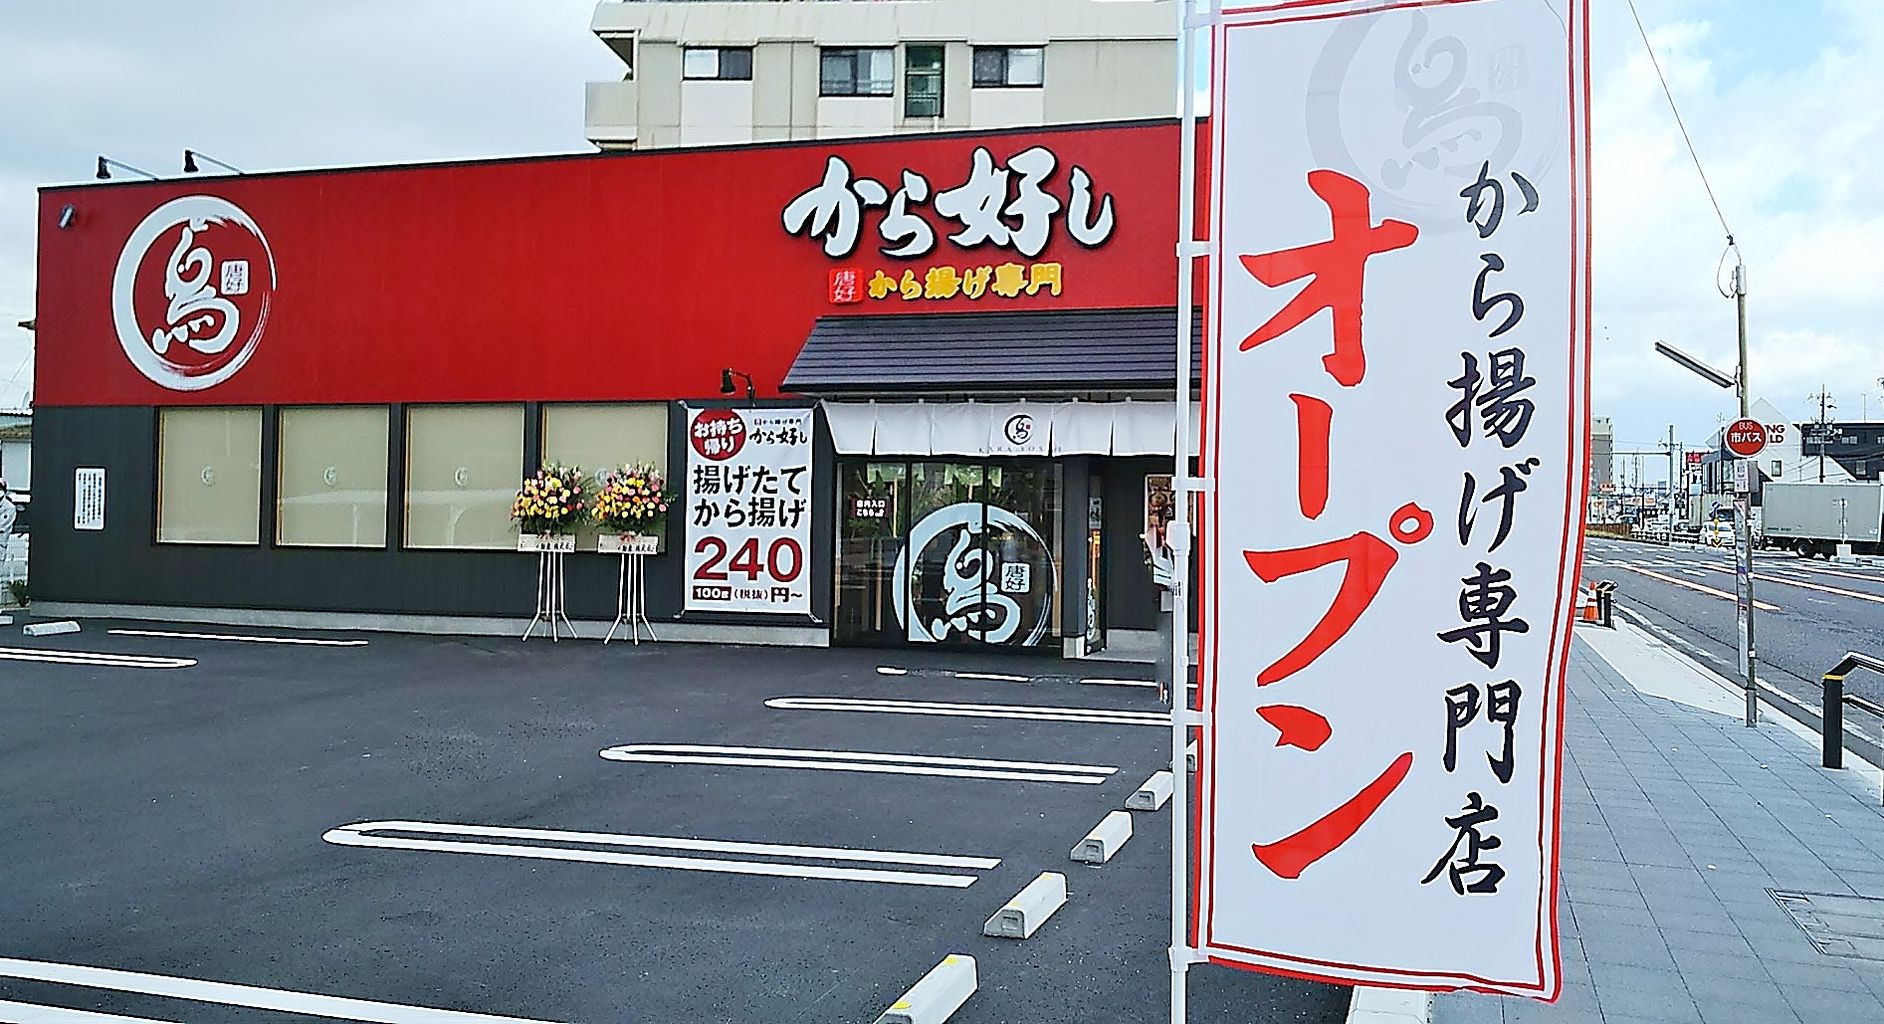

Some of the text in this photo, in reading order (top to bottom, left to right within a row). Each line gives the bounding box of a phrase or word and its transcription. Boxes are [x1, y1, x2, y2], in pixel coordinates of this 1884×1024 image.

[783, 147, 1114, 257] から好し
[868, 263, 1063, 300] から揚げ専門
[694, 417, 743, 438] お持ち
[749, 426, 807, 446] から好し
[1730, 432, 1762, 443] 市バス
[1738, 421, 1754, 430] BUS
[704, 437, 735, 455] 帰り
[693, 464, 807, 495] 揚げたて
[693, 497, 807, 529] から揚げ
[1239, 170, 1432, 878] オープン
[1422, 162, 1541, 895] から揚げ専門店
[693, 536, 803, 583] 240
[1004, 565, 1026, 591] 唐好
